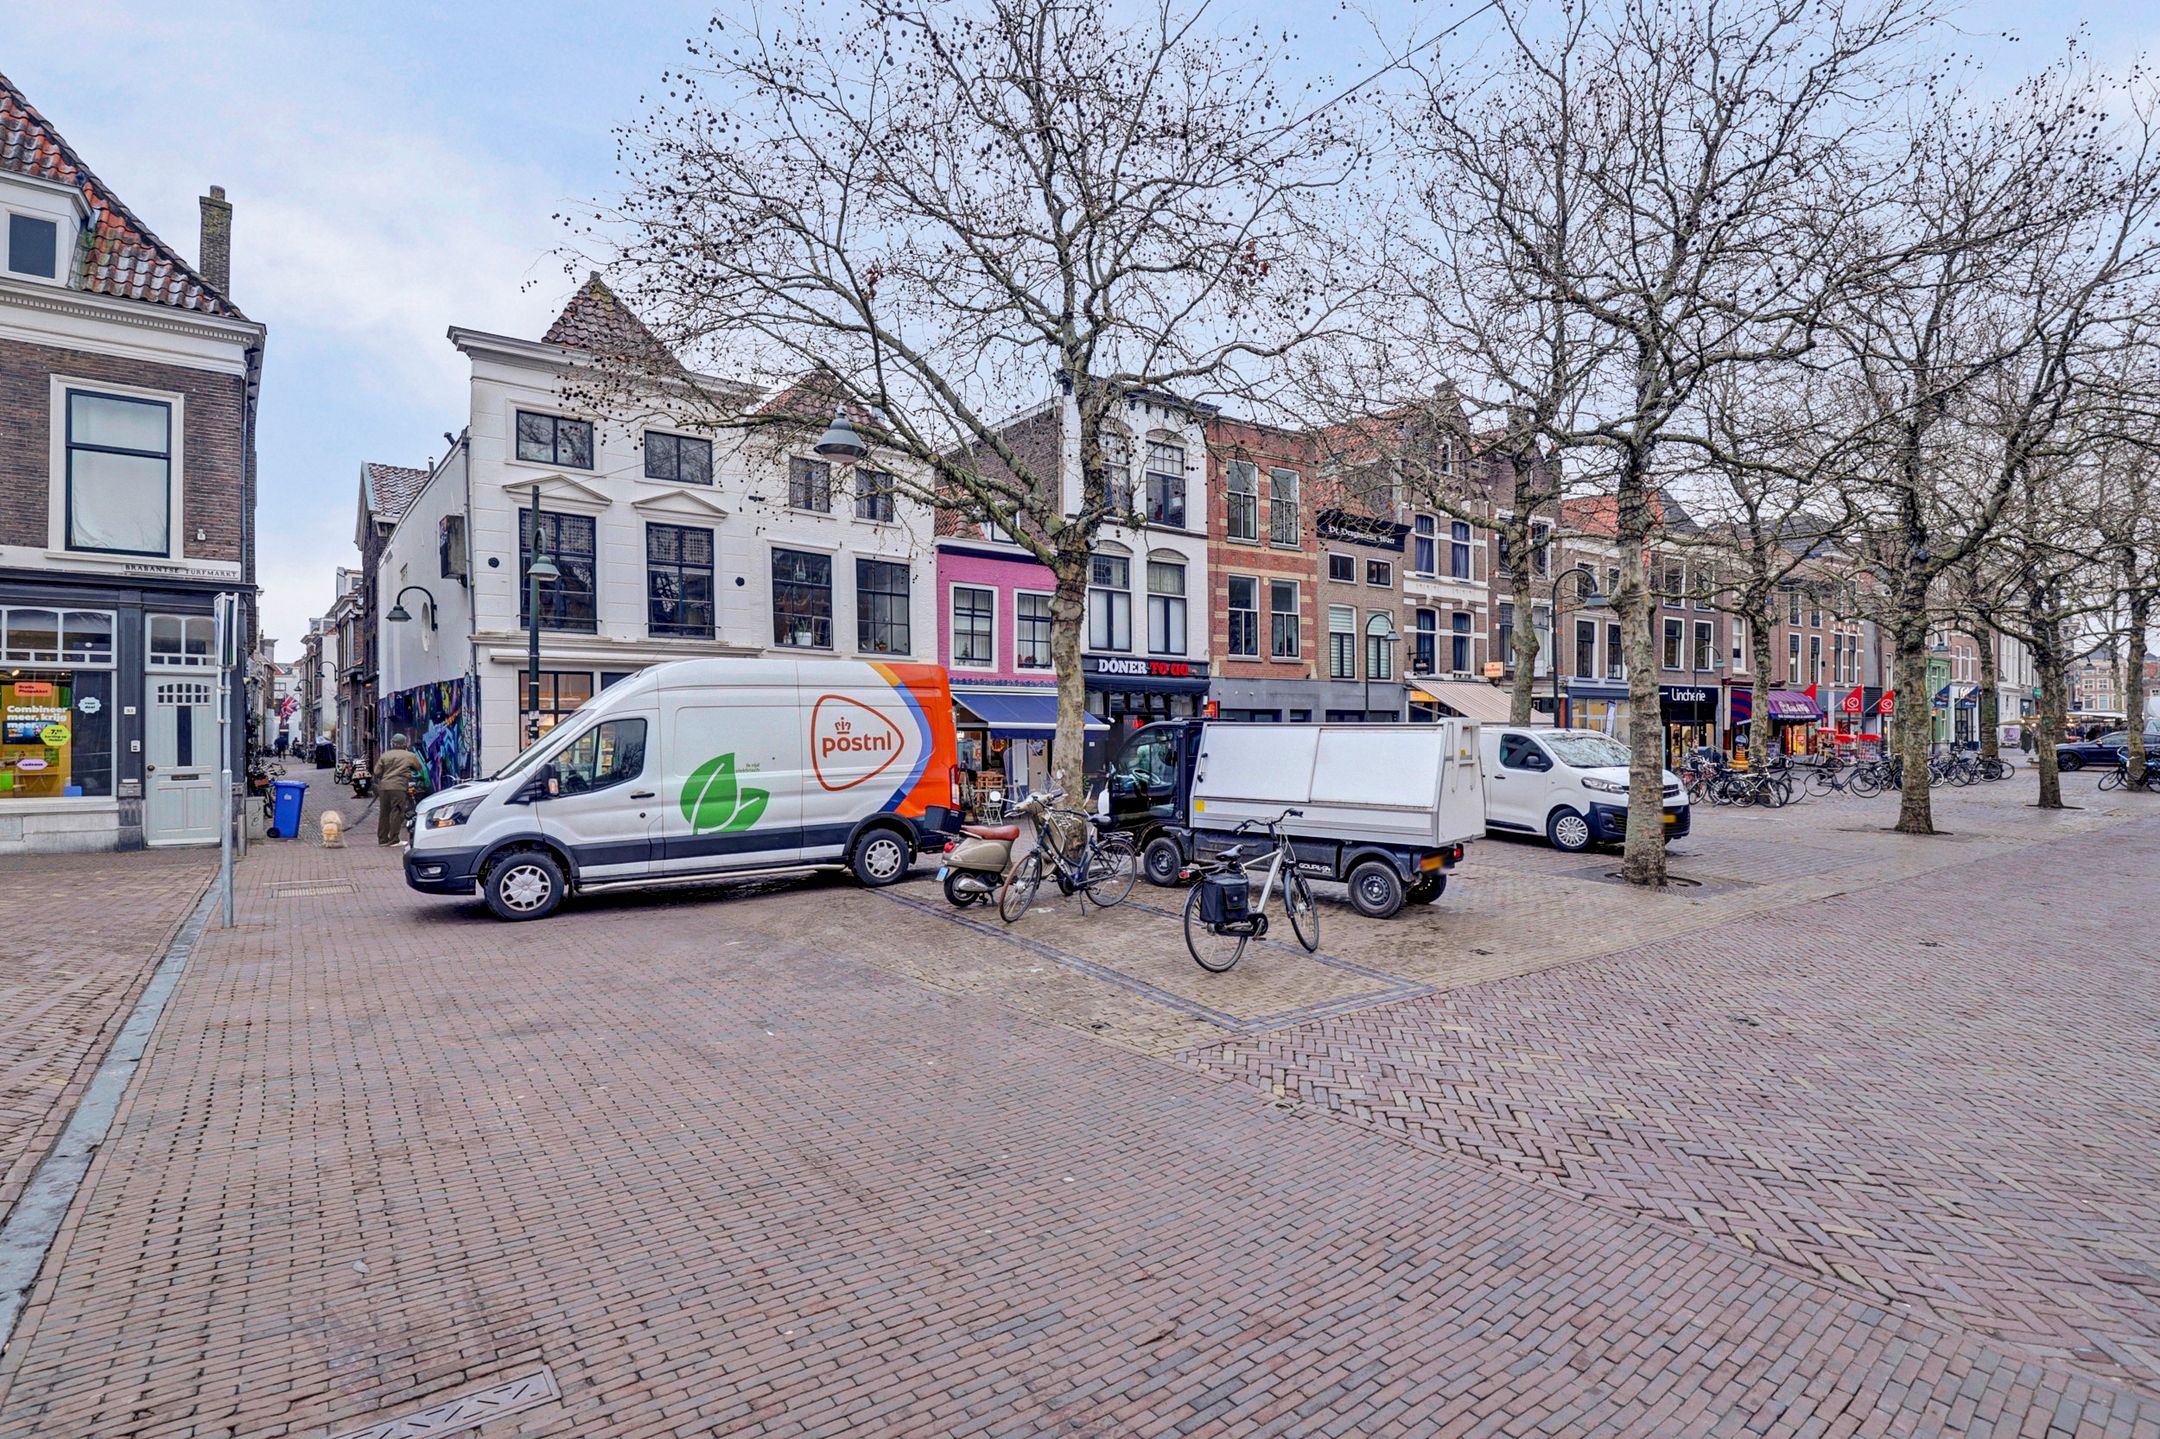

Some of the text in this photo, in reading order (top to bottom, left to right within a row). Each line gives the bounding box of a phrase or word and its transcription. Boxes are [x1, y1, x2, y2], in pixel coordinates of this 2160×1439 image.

[125, 564, 238, 578] BRABANTSE TURFMARKT
[1098, 657, 1190, 677] DÖNER TO GO
[1671, 687, 1706, 702] Lincherie
[6, 705, 67, 713] Combineer
[40, 713, 67, 722] krijg
[822, 730, 892, 758] postnl
